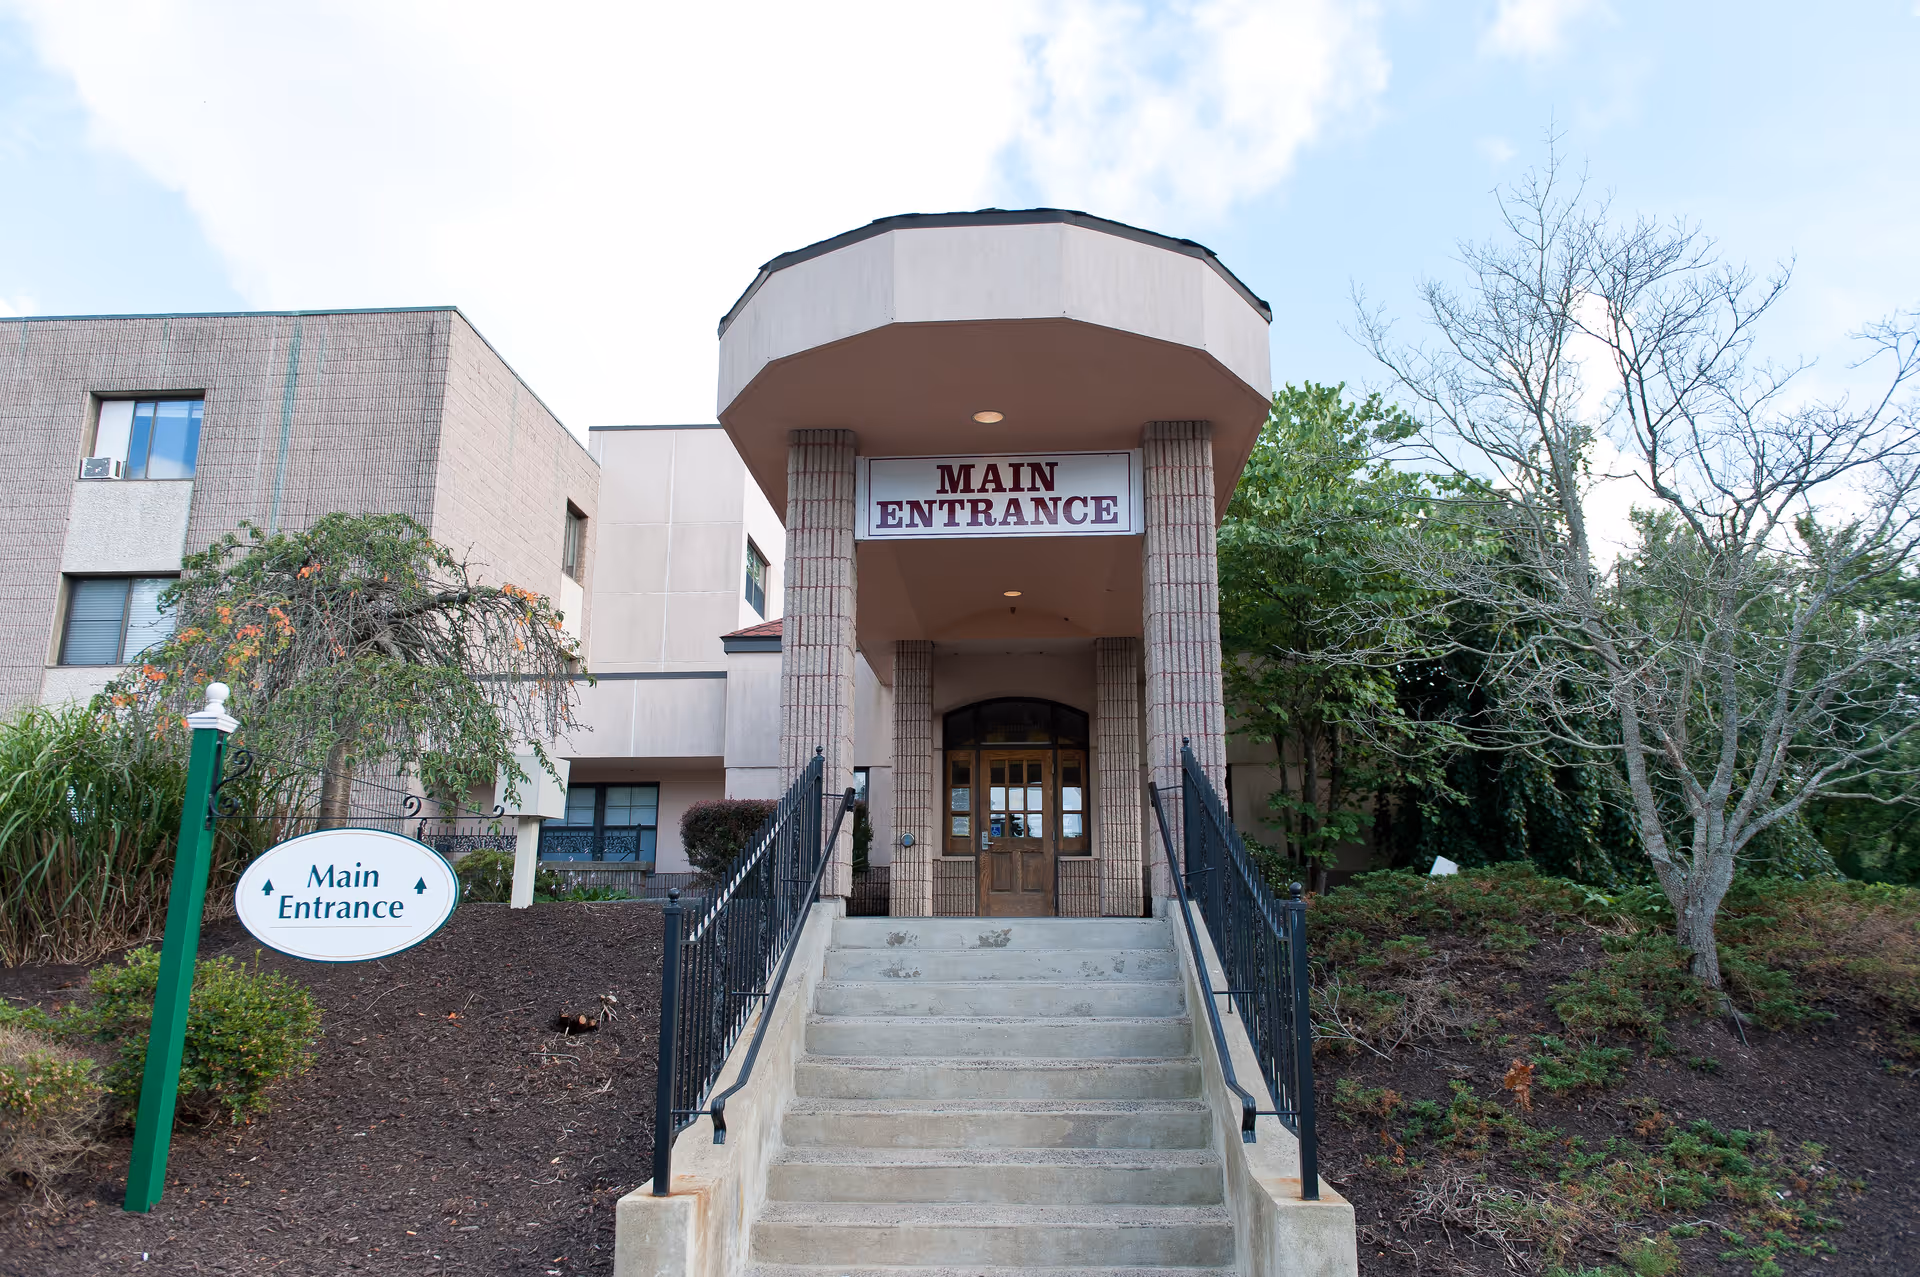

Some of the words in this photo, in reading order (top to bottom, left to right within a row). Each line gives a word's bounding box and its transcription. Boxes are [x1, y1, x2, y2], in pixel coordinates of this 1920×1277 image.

[936, 462, 1058, 494] MAIN
[876, 496, 1118, 528] ENTRANCE
[307, 862, 379, 888] Main
[278, 895, 404, 919] Entrance
